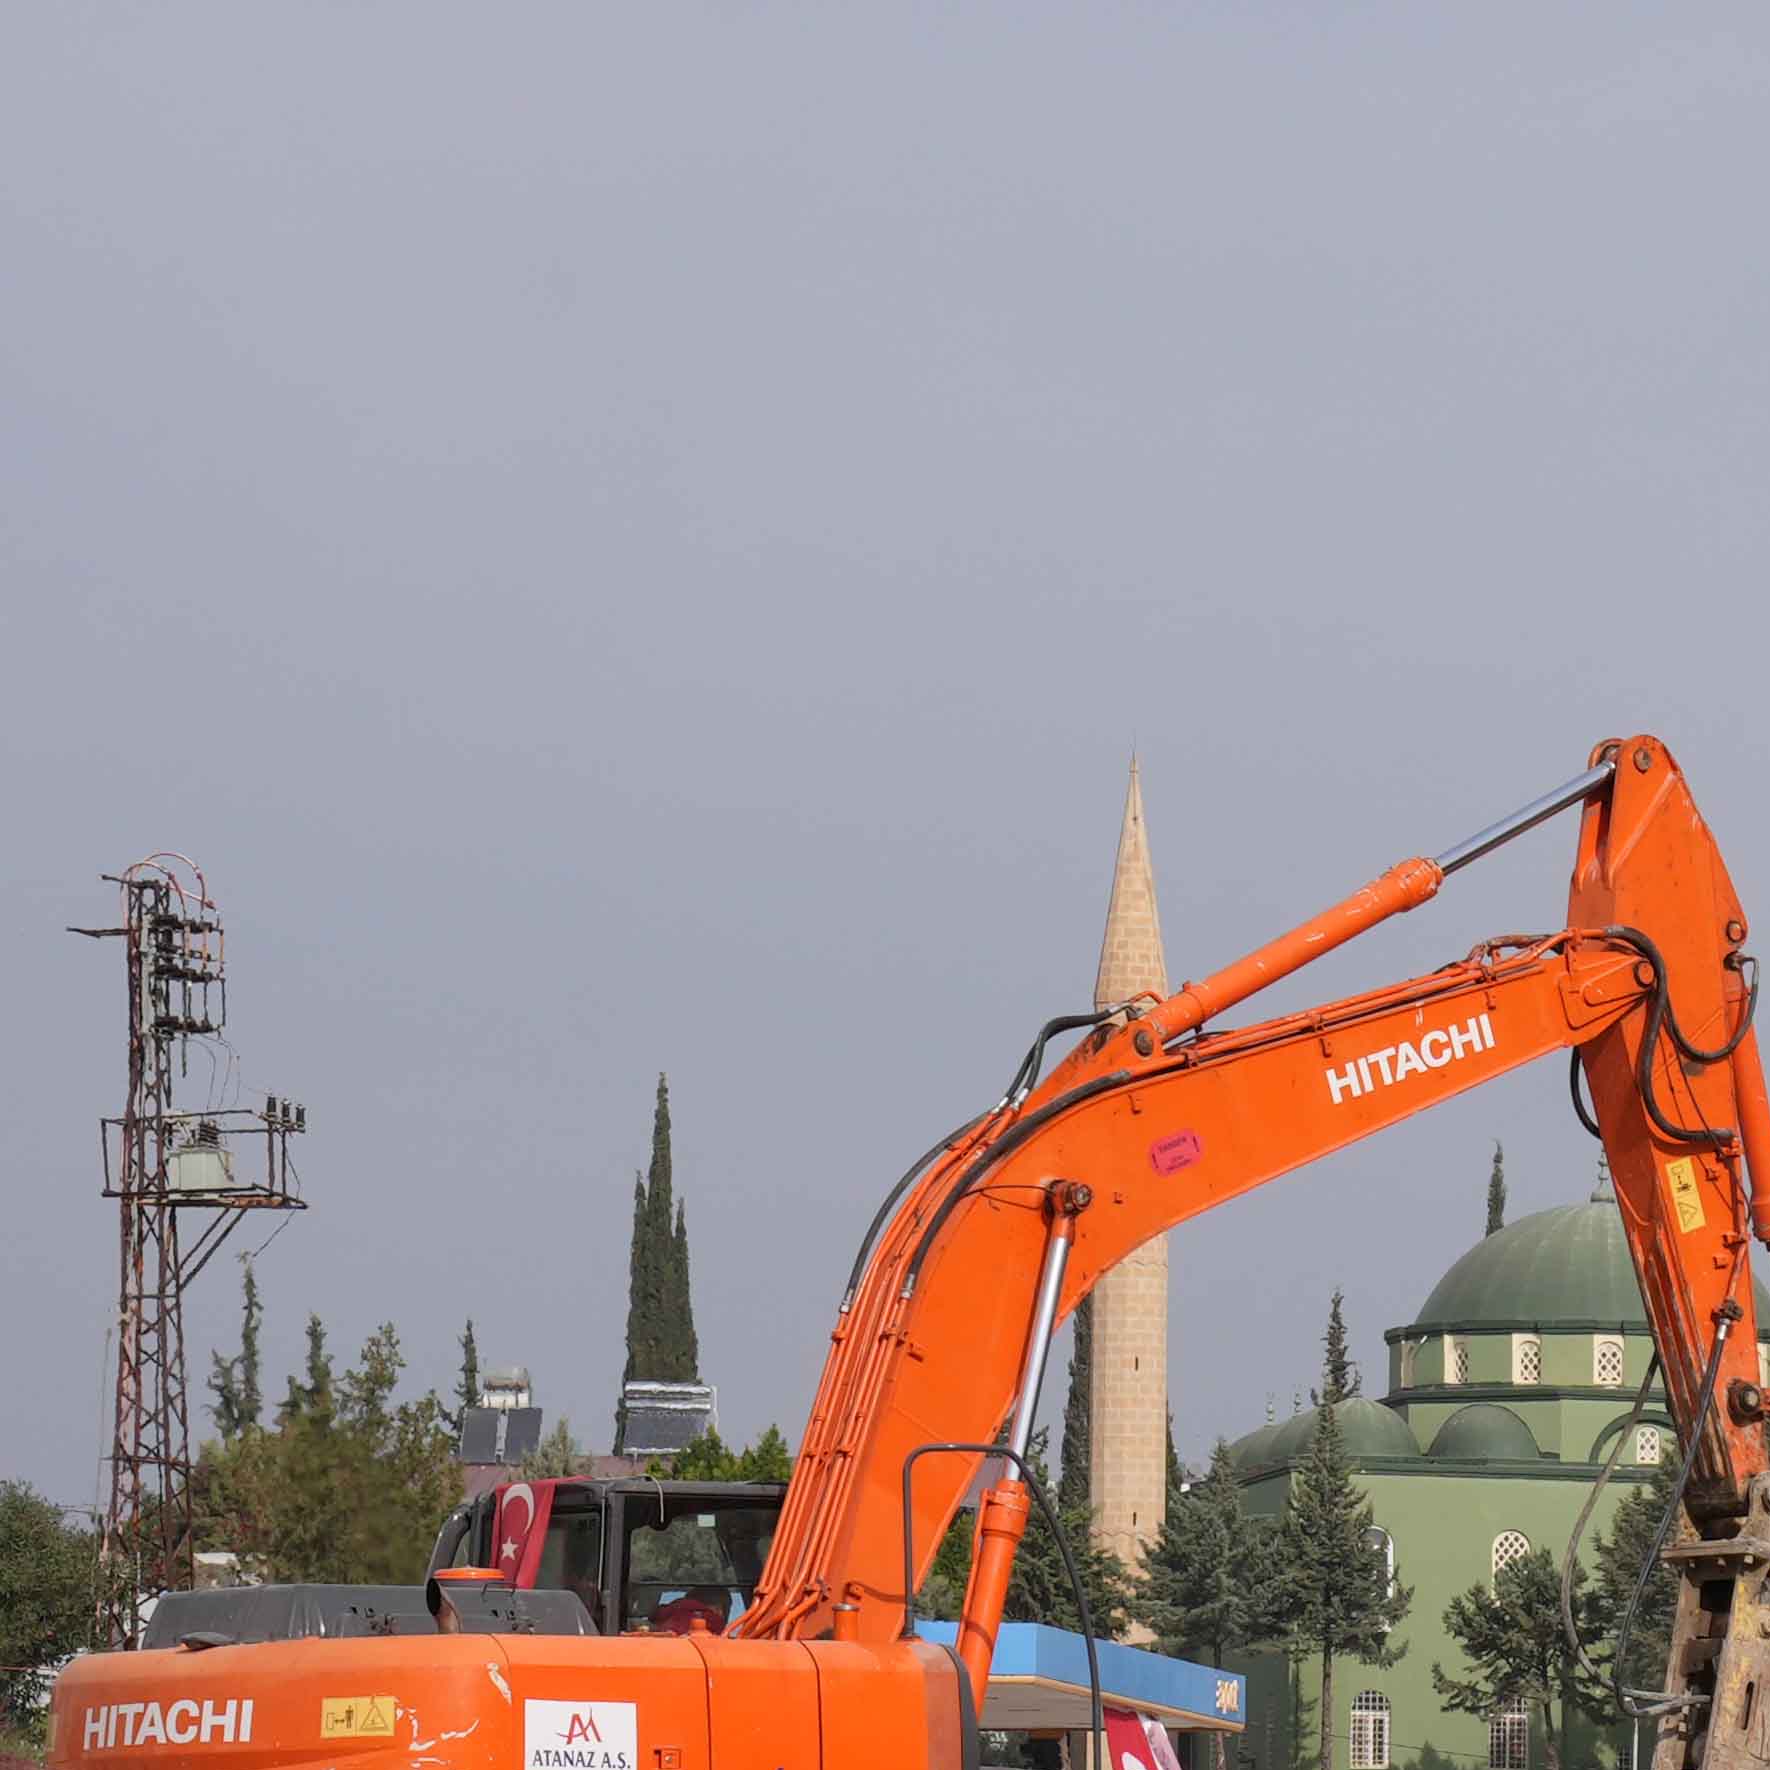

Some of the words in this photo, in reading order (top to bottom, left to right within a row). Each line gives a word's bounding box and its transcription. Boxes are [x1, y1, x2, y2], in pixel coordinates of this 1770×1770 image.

[1324, 1012, 1496, 1105] HITACHI
[82, 1698, 255, 1751] HITACHI
[532, 1749, 595, 1770] ATANAZ
